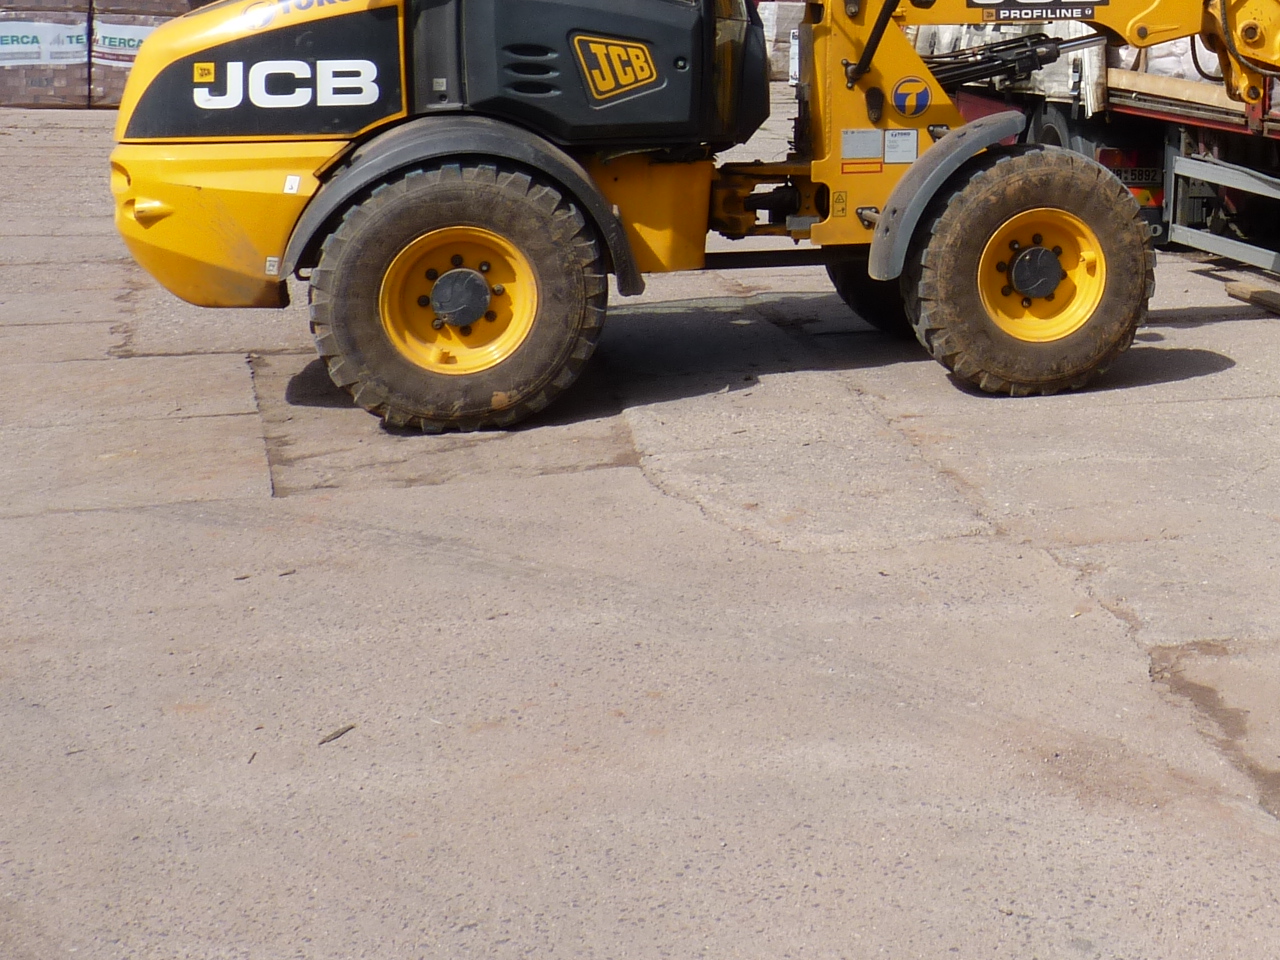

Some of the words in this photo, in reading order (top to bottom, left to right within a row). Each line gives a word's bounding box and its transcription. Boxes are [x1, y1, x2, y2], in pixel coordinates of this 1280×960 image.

[1000, 9, 1082, 19] PROFILINE
[589, 43, 651, 92] JCB
[193, 59, 380, 110] JCB
[1130, 169, 1157, 182] 5892
